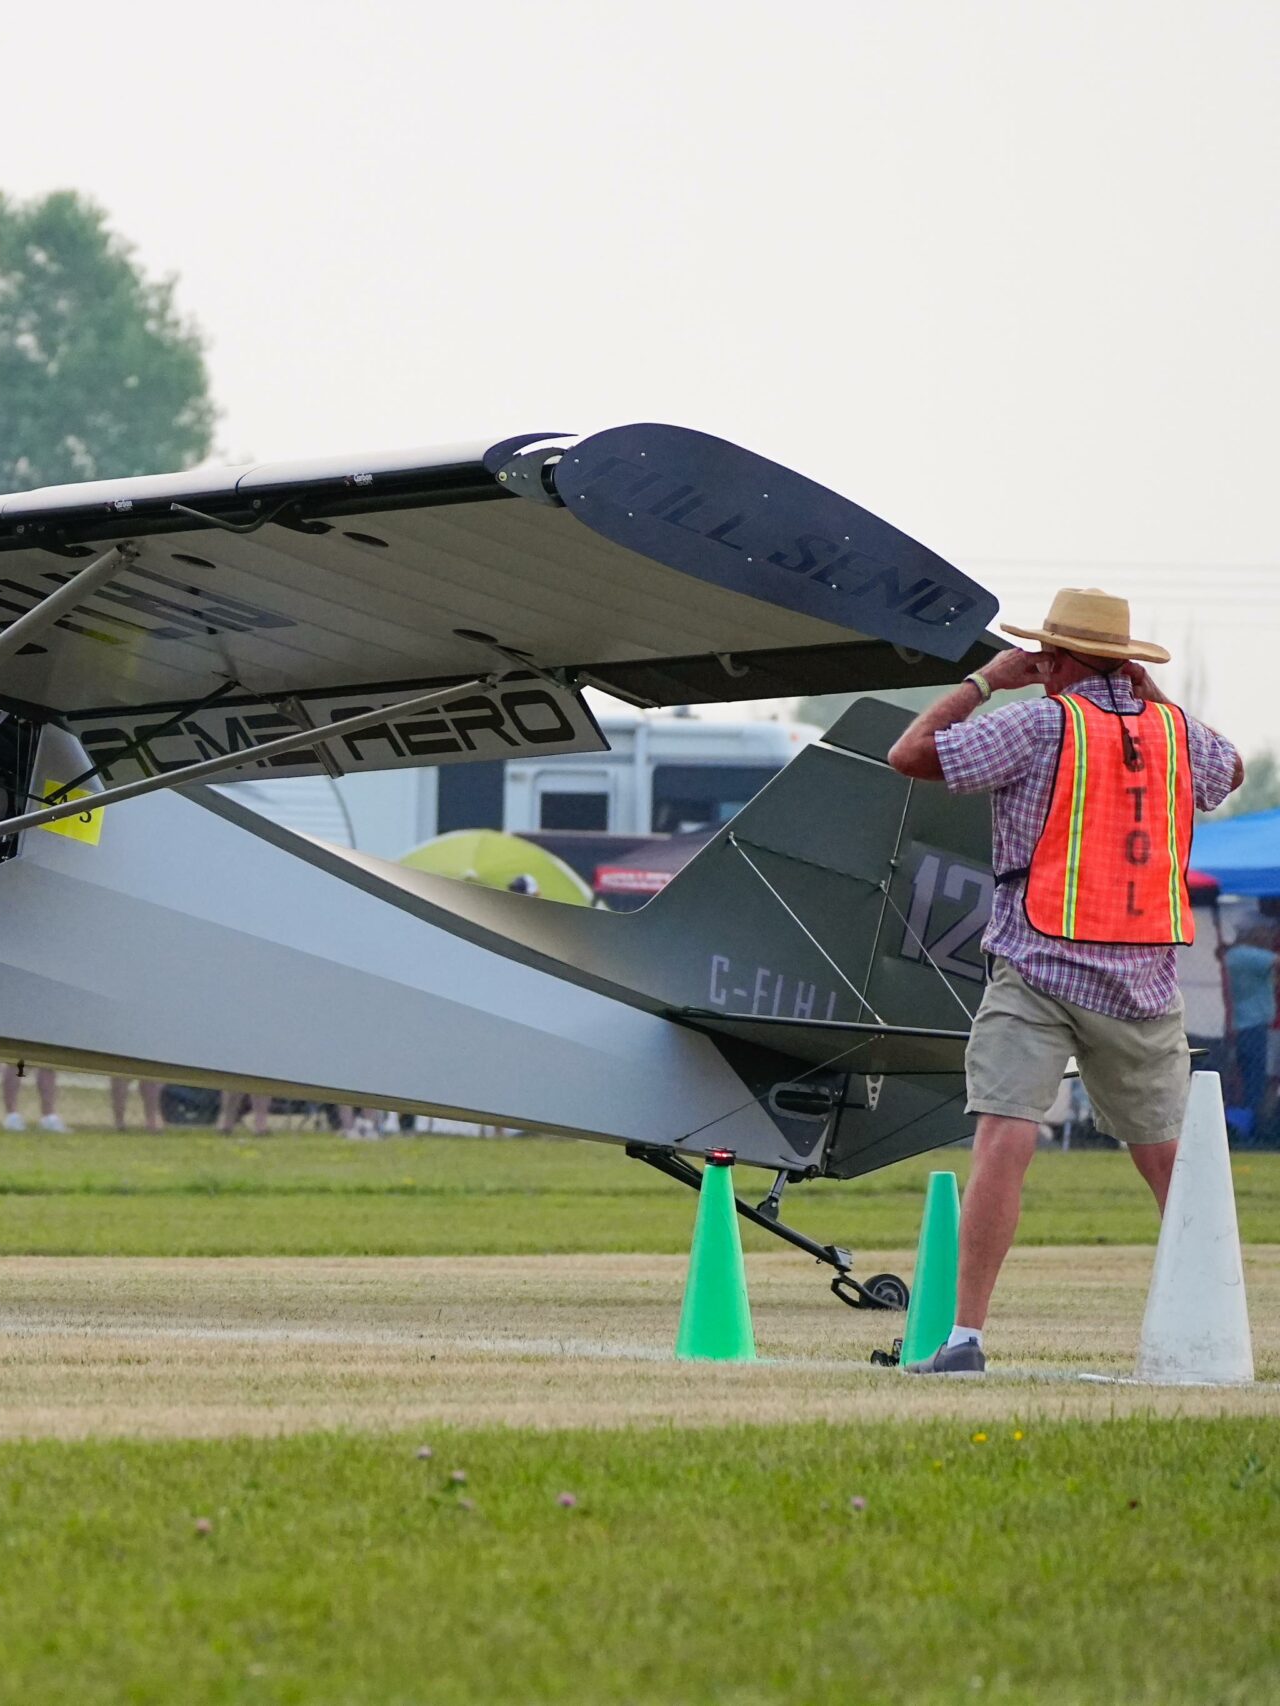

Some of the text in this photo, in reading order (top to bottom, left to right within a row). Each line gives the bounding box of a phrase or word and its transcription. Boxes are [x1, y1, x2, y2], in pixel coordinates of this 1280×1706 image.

[580, 456, 978, 627] FULL SEND
[81, 690, 576, 780] ACME AERO
[899, 854, 996, 983] 12
